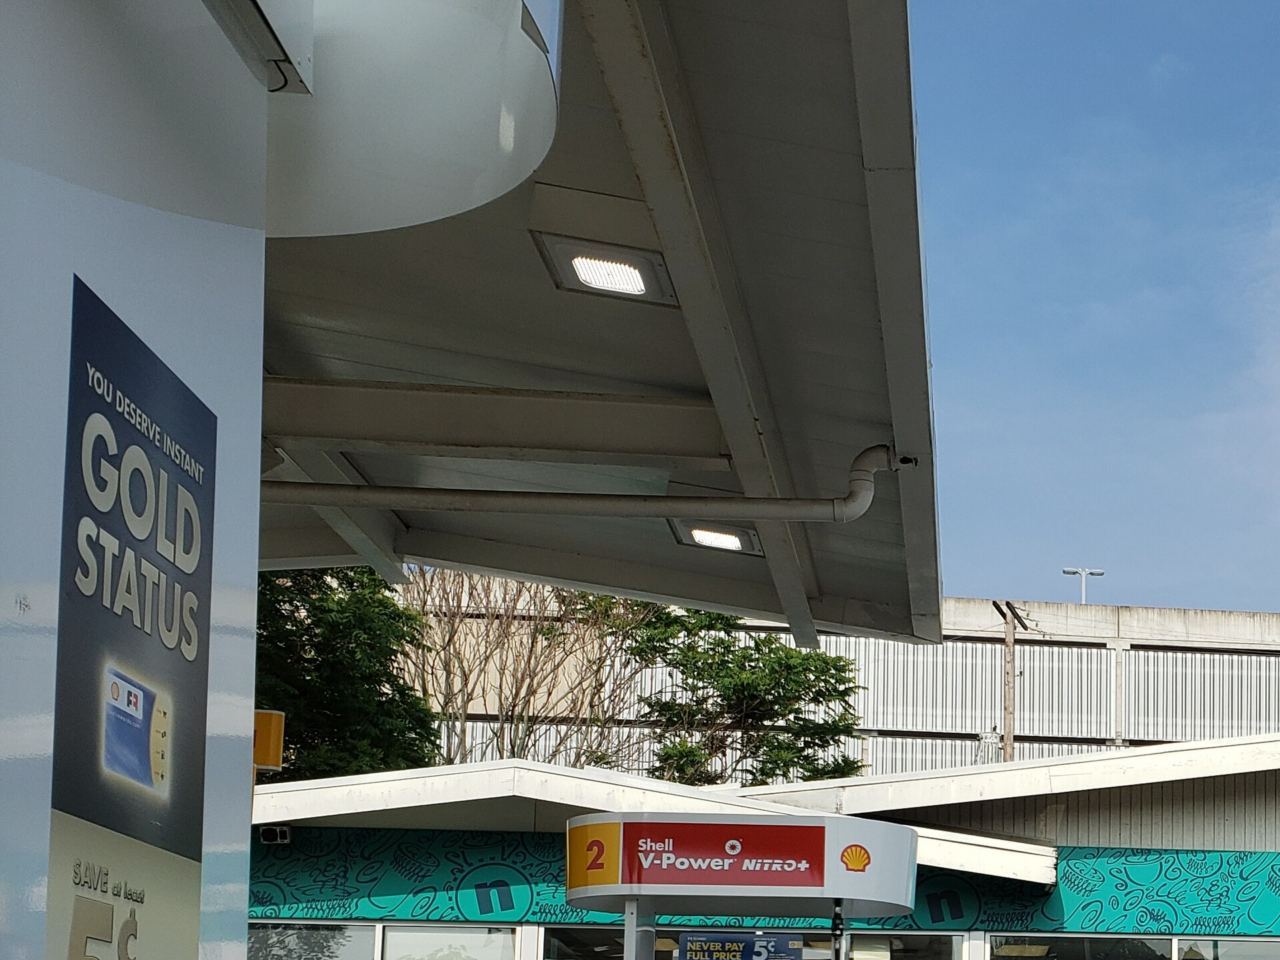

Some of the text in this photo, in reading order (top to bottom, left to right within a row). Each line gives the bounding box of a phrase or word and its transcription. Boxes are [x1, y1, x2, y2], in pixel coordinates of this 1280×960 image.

[86, 362, 204, 485] YOU DESERVE INSTANT
[81, 413, 201, 575] GOLD
[75, 516, 198, 662] STATUS
[586, 839, 605, 871] 2
[638, 838, 673, 851] Shell
[638, 852, 735, 871] V-Power
[73, 859, 145, 904] SAVE at least
[686, 951, 742, 960] FULL PRICE
[687, 941, 745, 951] NEVER PAY
